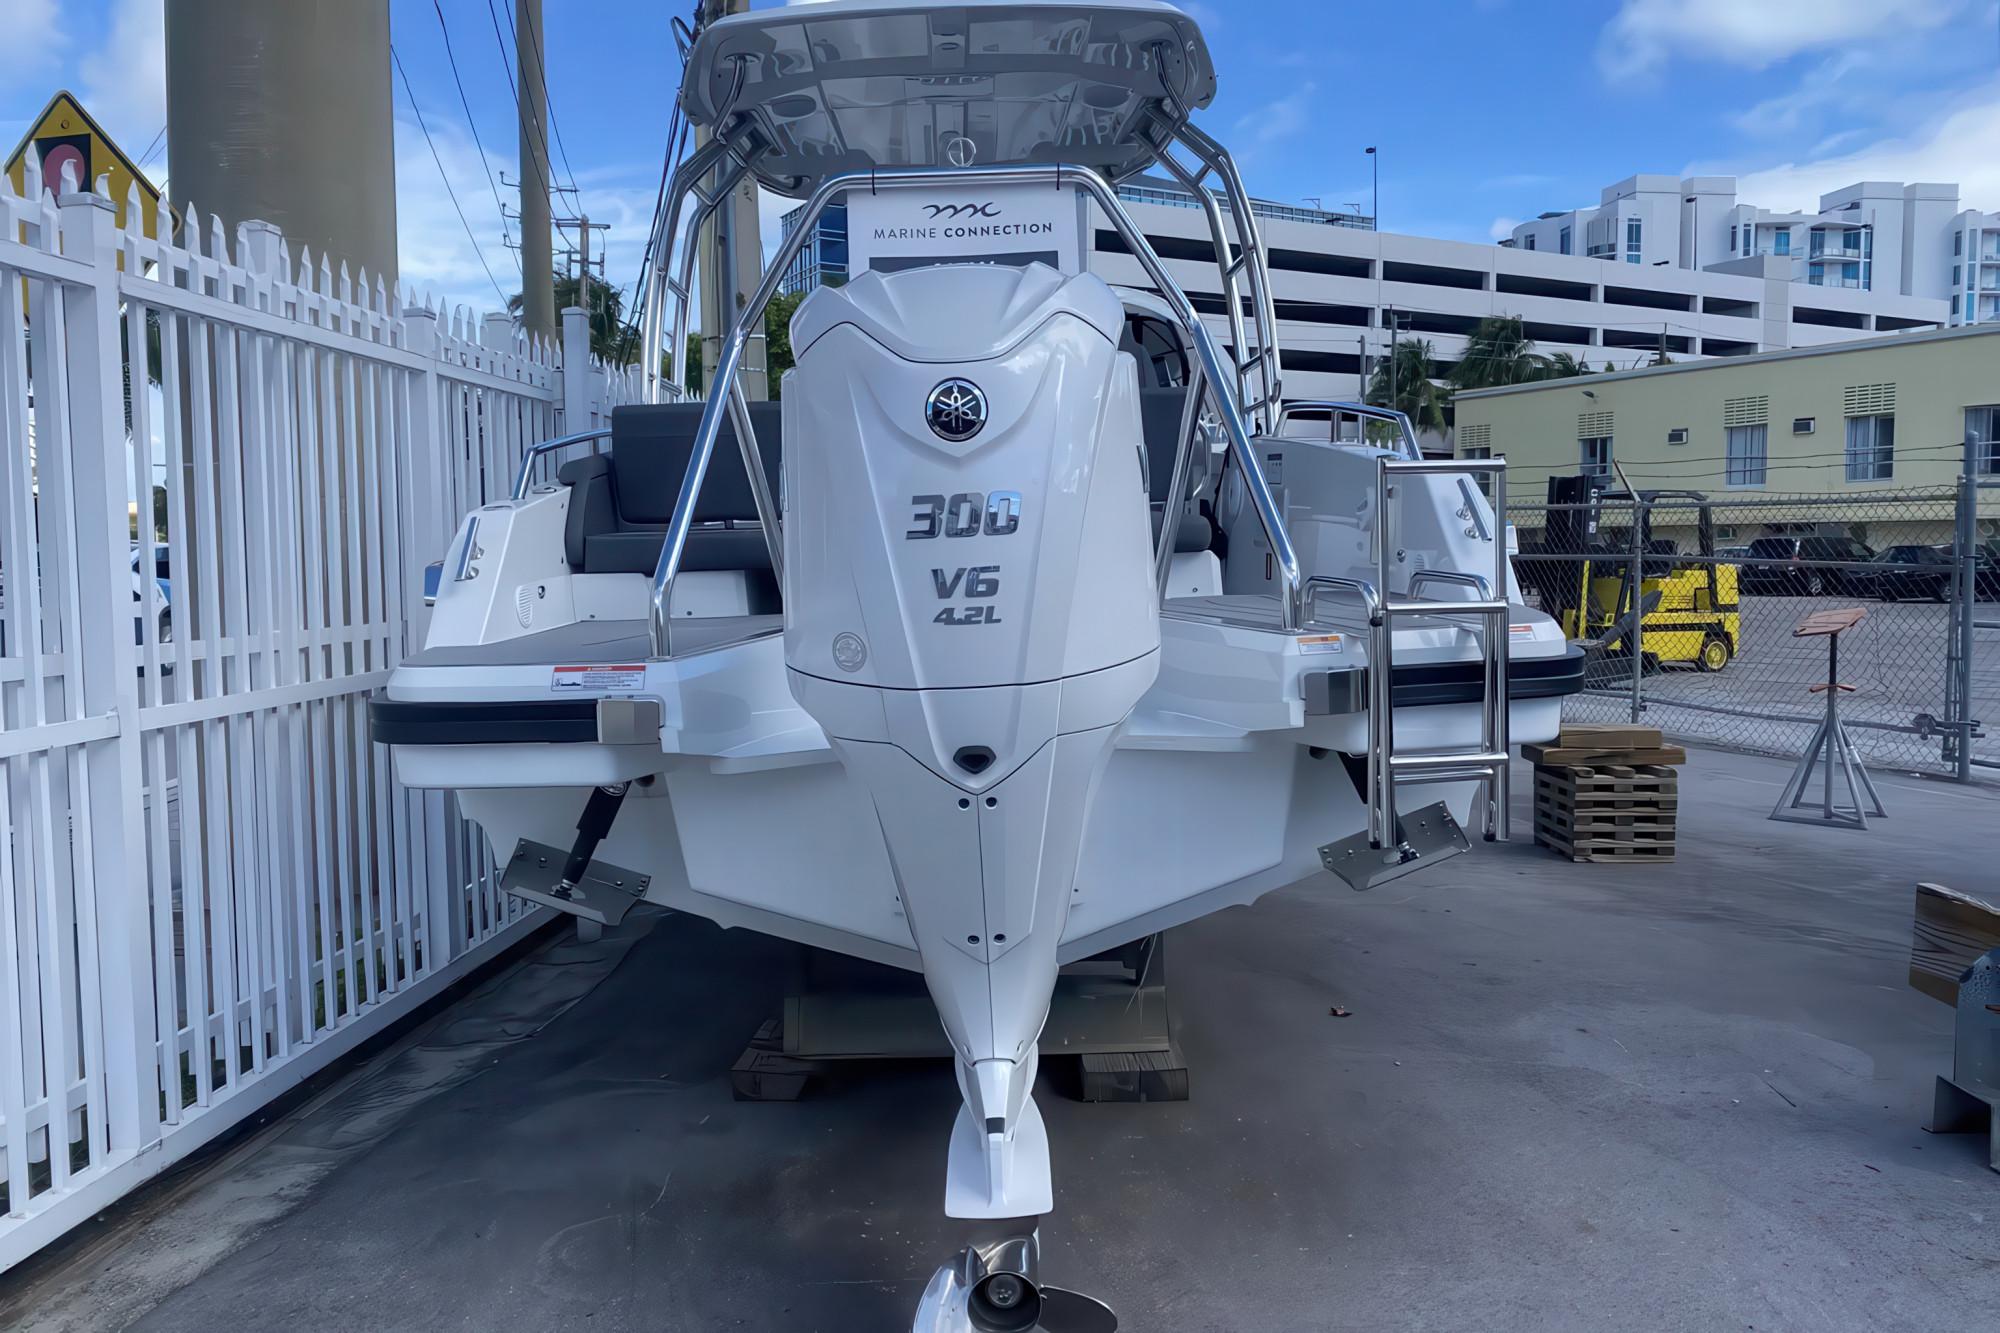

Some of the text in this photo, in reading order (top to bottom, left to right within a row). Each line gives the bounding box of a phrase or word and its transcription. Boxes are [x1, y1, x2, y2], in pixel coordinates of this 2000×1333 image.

[874, 222, 1052, 239] MARINE CONNECTION
[905, 490, 1022, 540] 300
[931, 565, 1000, 599] V6
[933, 606, 1002, 625] 4.2L
